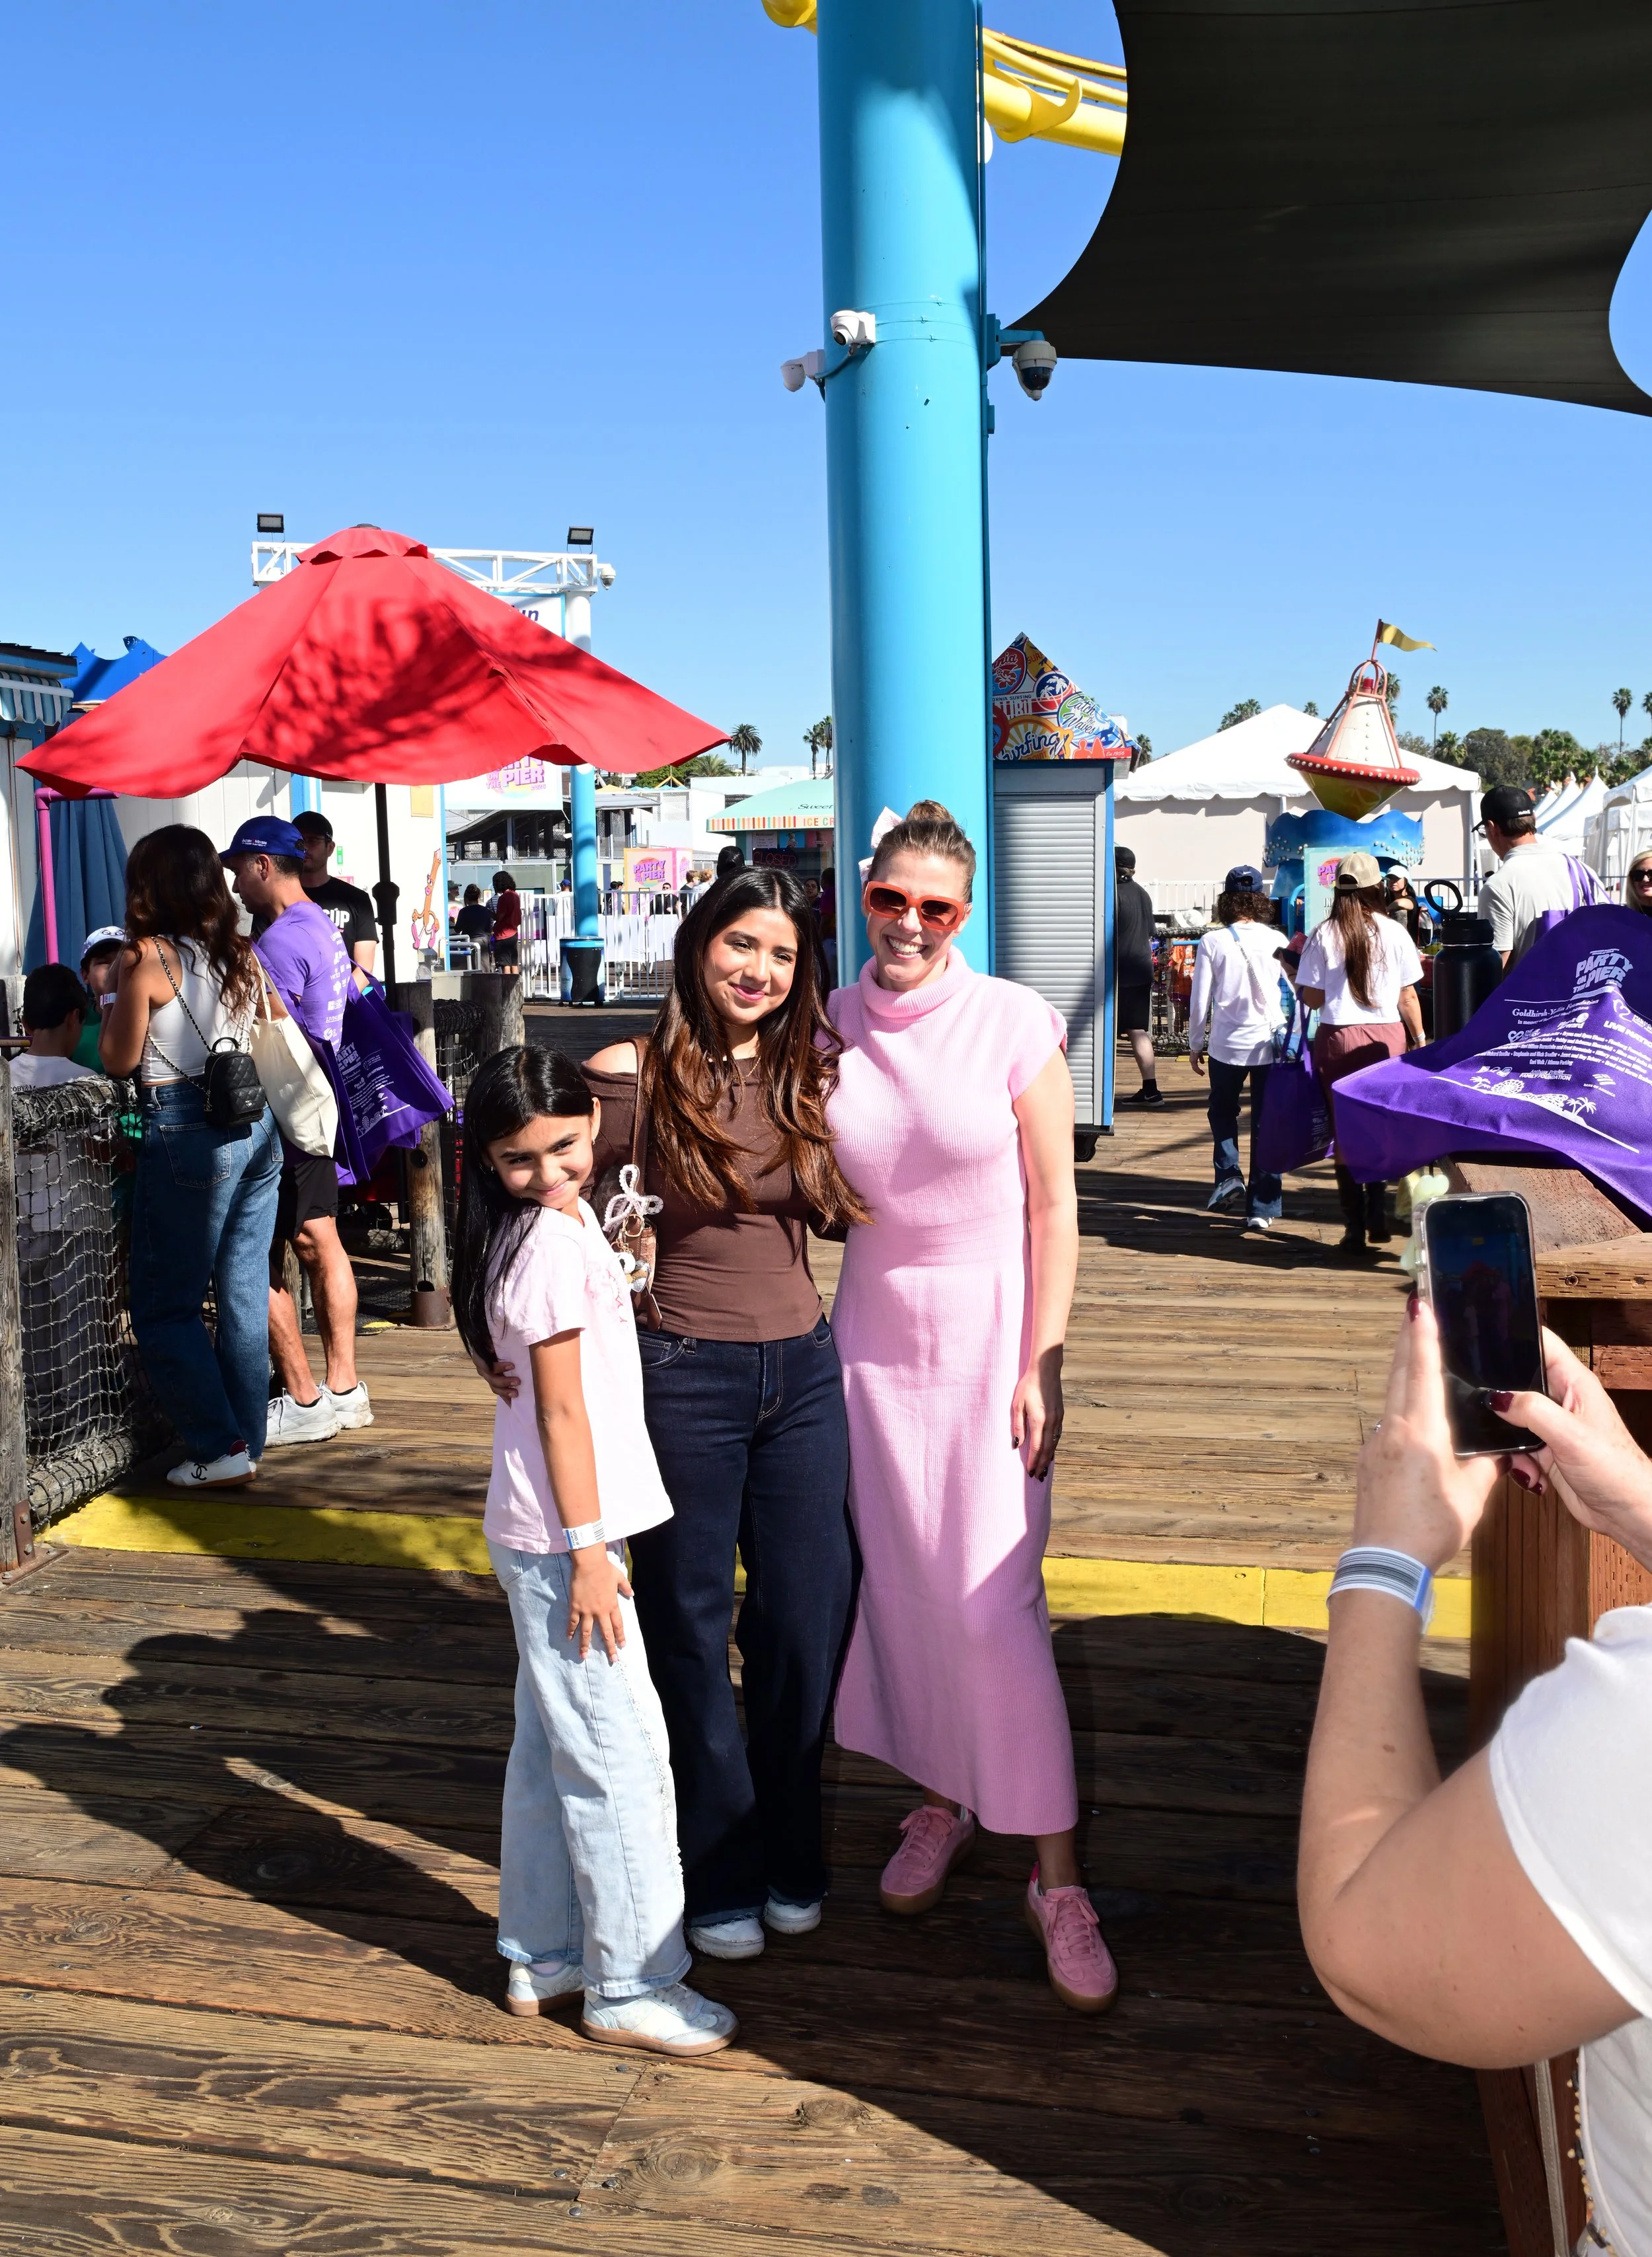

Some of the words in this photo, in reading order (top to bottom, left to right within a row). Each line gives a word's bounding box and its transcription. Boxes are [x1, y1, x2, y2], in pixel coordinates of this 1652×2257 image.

[1067, 696, 1095, 716] Catch
[1063, 713, 1096, 734] Waves
[1087, 717, 1096, 725] the
[502, 768, 544, 788] PIER
[803, 818, 819, 827] ICE
[633, 860, 666, 874] PARTY
[753, 851, 797, 867] CLOSED
[642, 870, 665, 883] PIER
[1576, 953, 1633, 978] PARTY
[1585, 966, 1626, 988] PIER
[1603, 1020, 1627, 1033] LIVE
[342, 1050, 359, 1068] PIER
[1536, 1072, 1571, 1081] FOUNDATION
